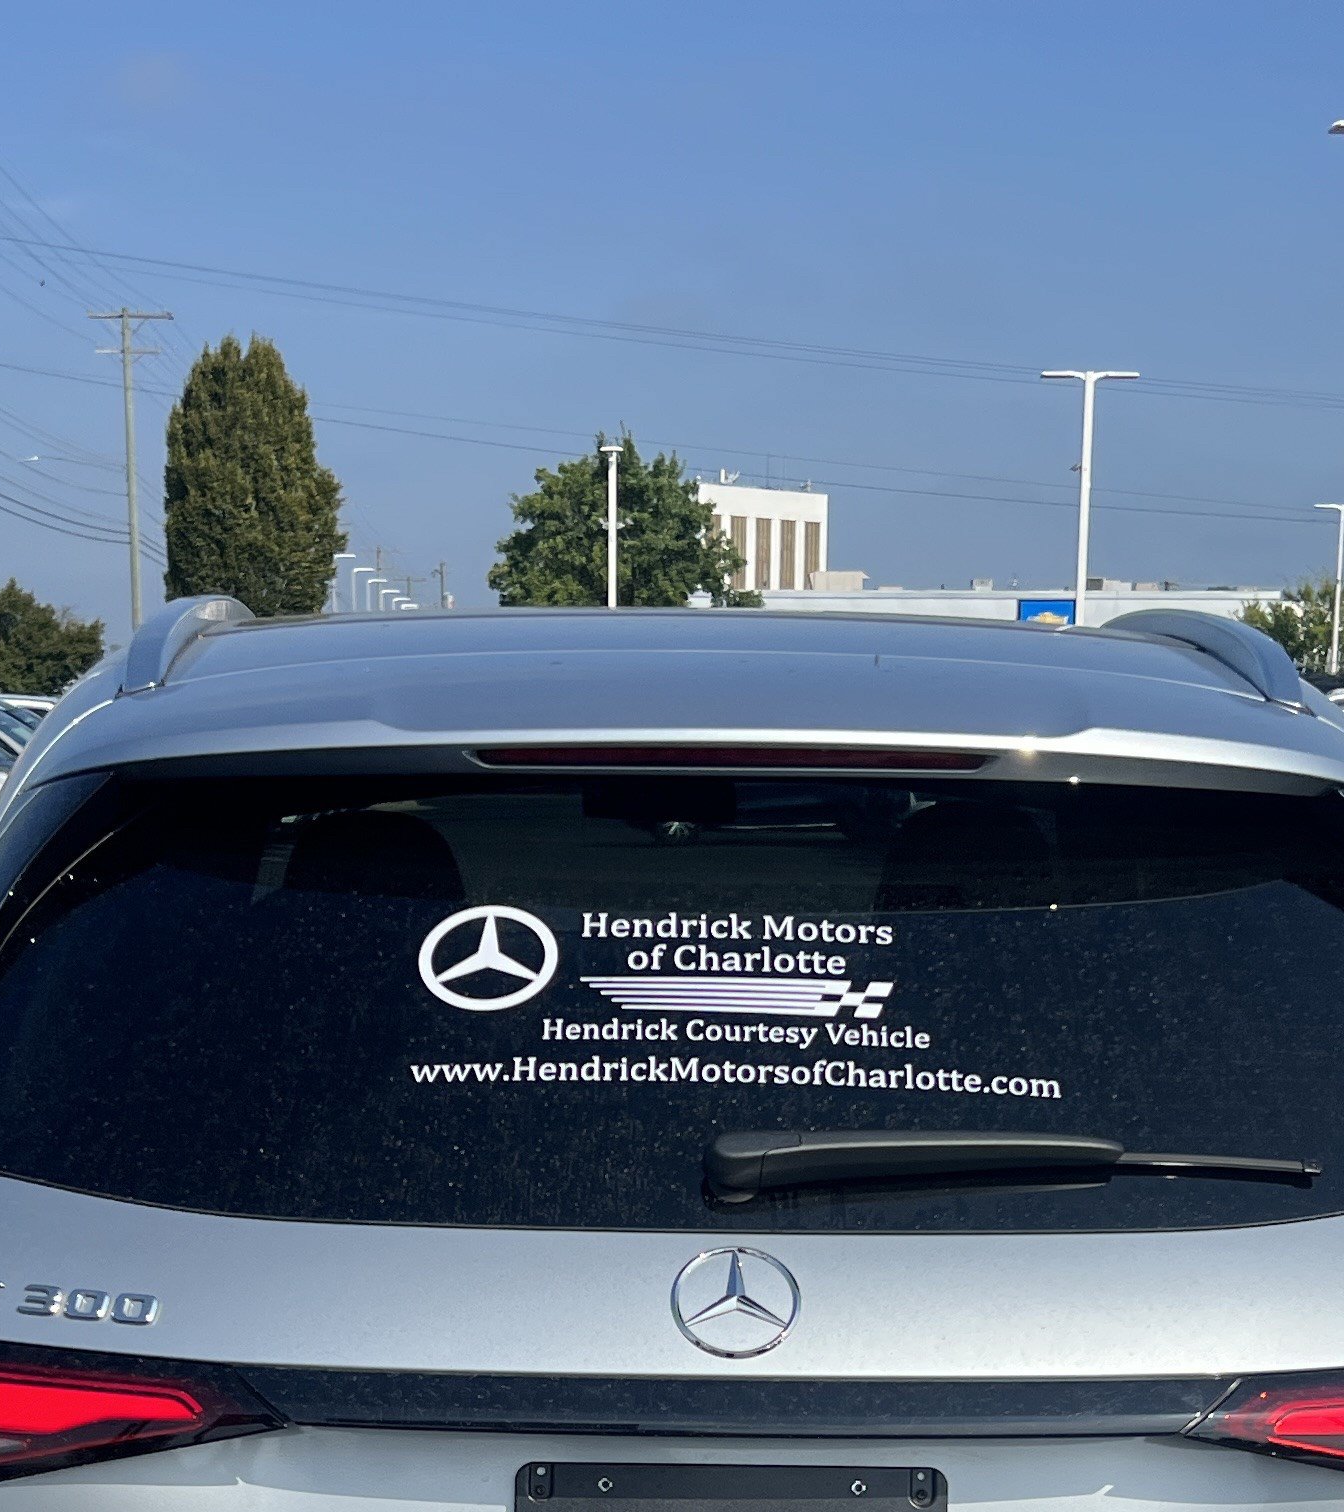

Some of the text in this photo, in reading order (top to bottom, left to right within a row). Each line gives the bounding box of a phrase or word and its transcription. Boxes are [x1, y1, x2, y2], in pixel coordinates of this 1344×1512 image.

[581, 912, 894, 945] Hendrick Motors
[627, 944, 846, 975] of Charlotte
[542, 1018, 930, 1049] Hendrick Courtesy Vehicle
[410, 1056, 1062, 1099] www.HendrickMotorsofCharlotte.com
[16, 1284, 159, 1325] 300
